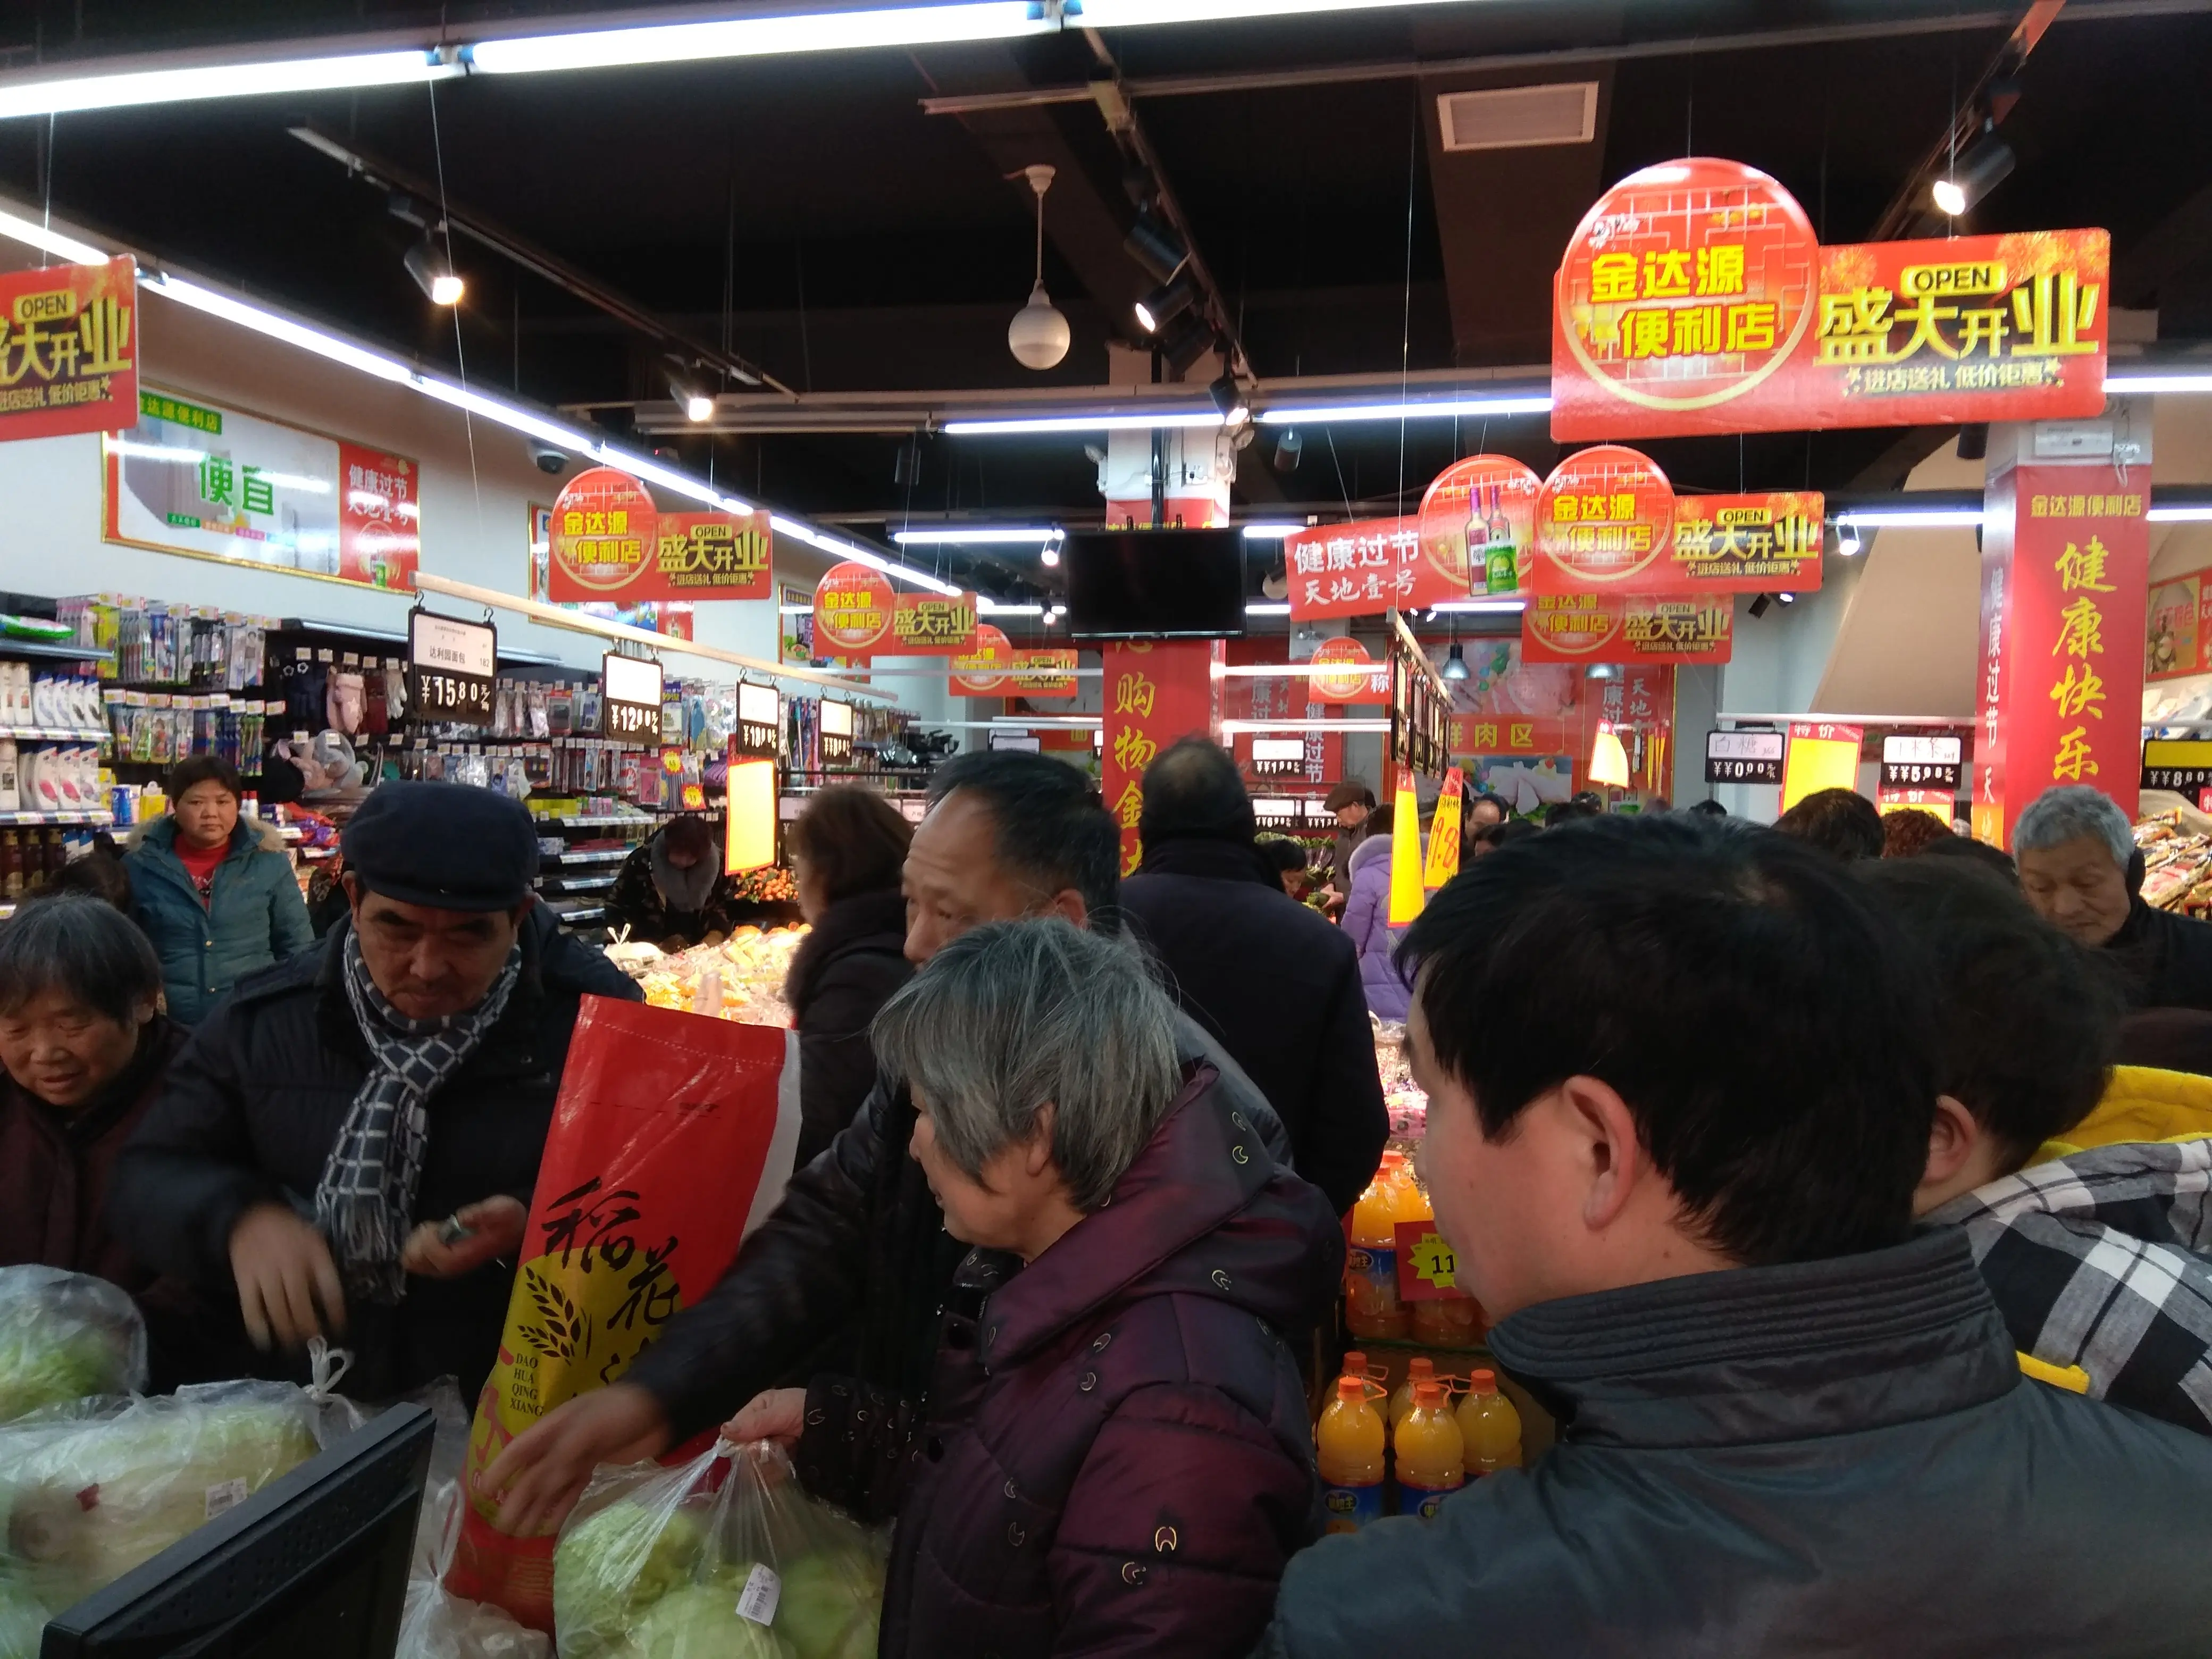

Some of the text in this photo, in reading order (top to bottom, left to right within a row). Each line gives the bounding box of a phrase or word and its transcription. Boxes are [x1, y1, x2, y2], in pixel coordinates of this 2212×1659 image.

[1591, 244, 1745, 303] 金达源
[1914, 265, 1990, 290] OPEN
[21, 294, 67, 317] OPEN
[1622, 303, 1775, 358] 便利店
[1813, 272, 2100, 367] 盛大开业
[1553, 493, 1635, 522] 金达源
[1724, 510, 1763, 522] OPEN
[2031, 495, 2142, 517] 金达源便利店
[564, 510, 627, 535] 金达源
[696, 526, 726, 537] OPEN
[1570, 525, 1651, 552] 便利店
[1670, 514, 1819, 562] 盛大开业
[577, 539, 640, 564] 便利店
[656, 530, 768, 573] 盛大开业
[1294, 530, 1419, 576] 健康过节
[825, 591, 872, 608] 金达源
[1304, 569, 1417, 606] 天地壹号
[834, 612, 881, 629] 便利店
[893, 606, 976, 635] 盛大开业
[1661, 604, 1690, 613] OPEN
[1549, 614, 1610, 632] 便利店
[1623, 607, 1730, 641] 盛大开业
[1986, 566, 2004, 749] 健康过节
[2050, 534, 2118, 781] 健康快乐
[1112, 641, 1157, 878] 购物金
[516, 1353, 538, 1369] DAO
[514, 1368, 534, 1384] HUA
[512, 1384, 538, 1401] QING
[510, 1398, 544, 1417] XIANG
